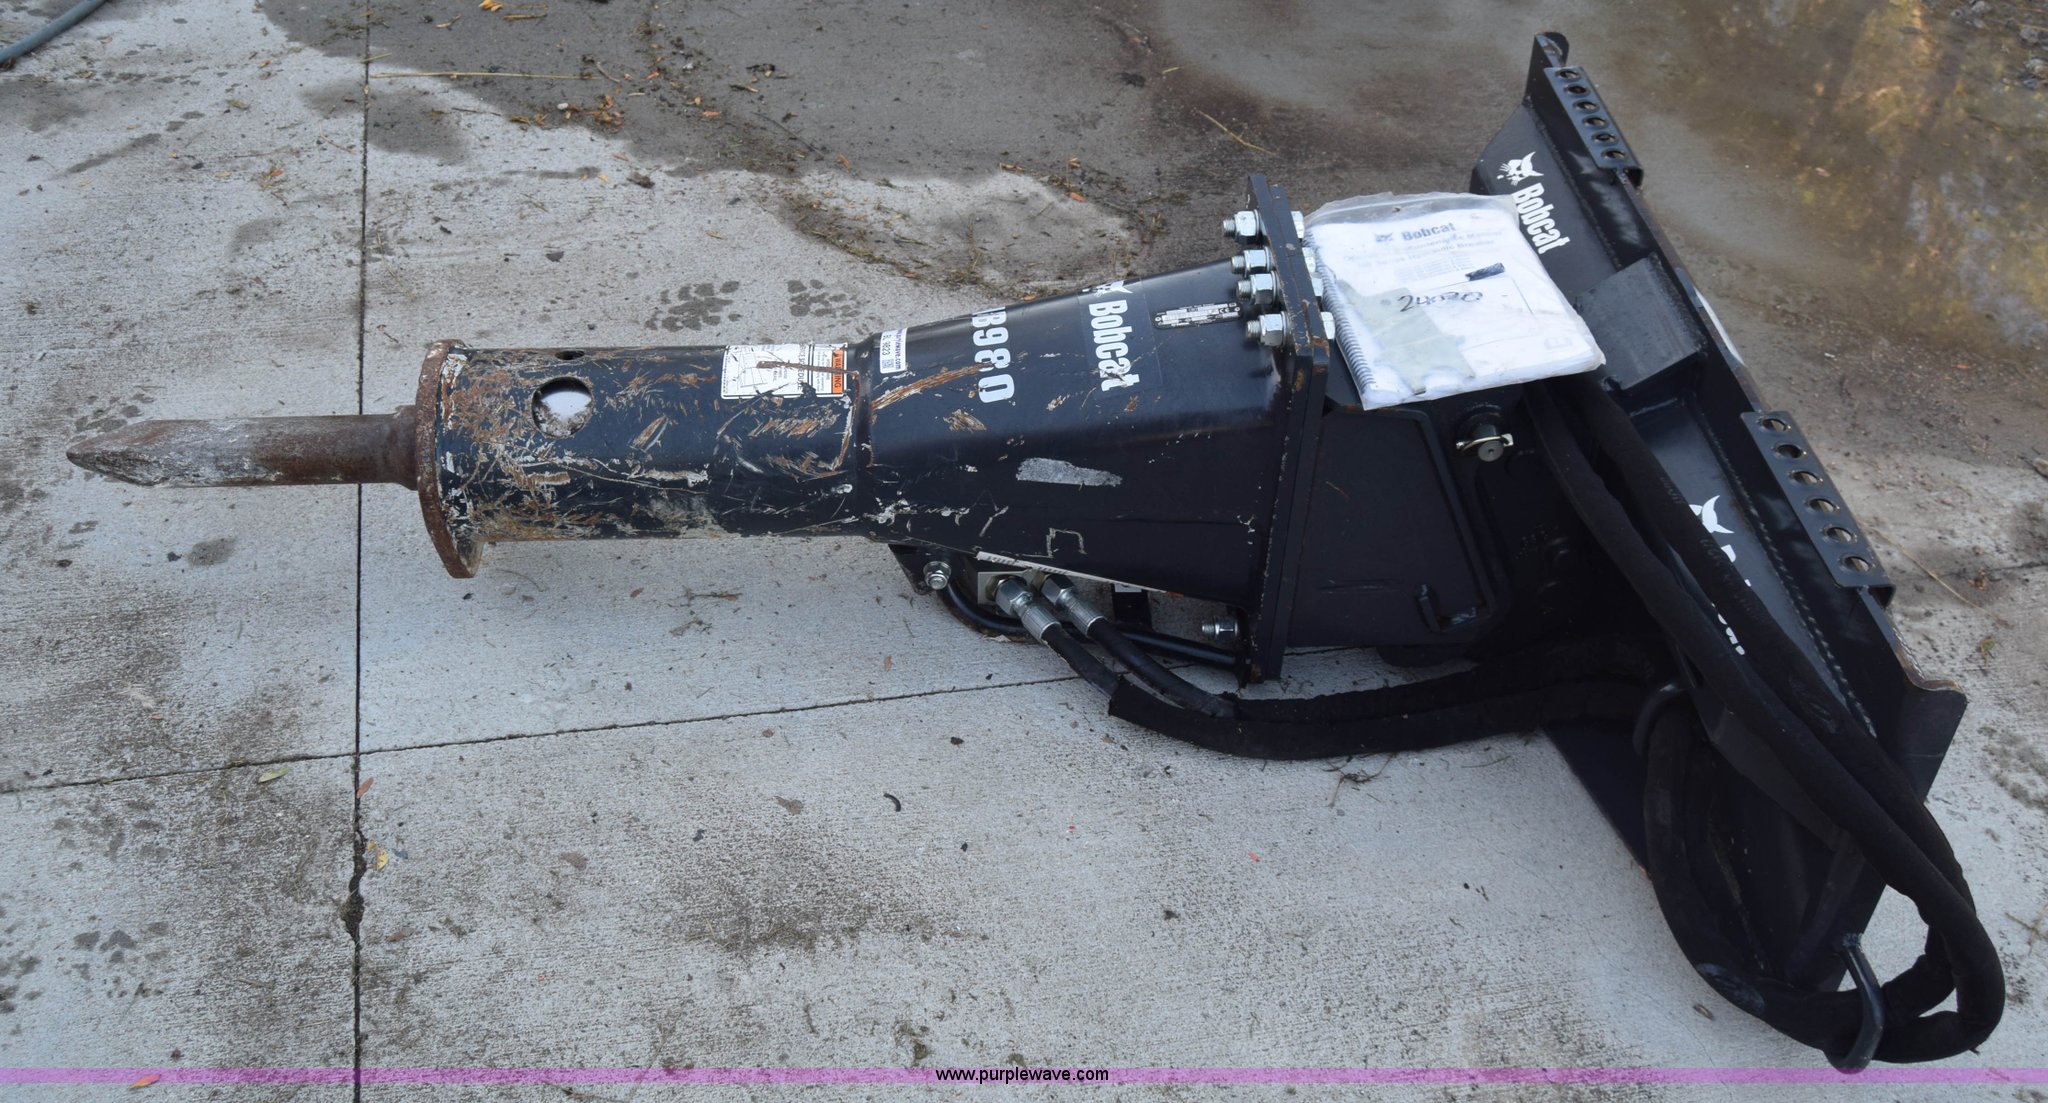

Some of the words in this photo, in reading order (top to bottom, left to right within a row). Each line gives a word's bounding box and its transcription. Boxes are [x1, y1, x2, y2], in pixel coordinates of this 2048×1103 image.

[1401, 222, 1457, 241] Bobcat
[1511, 182, 1570, 254] Bobcat
[971, 306, 1015, 404] B980
[1088, 299, 1140, 392] Bobcat
[797, 358, 806, 390] SCEDUE
[834, 357, 842, 388] WAING
